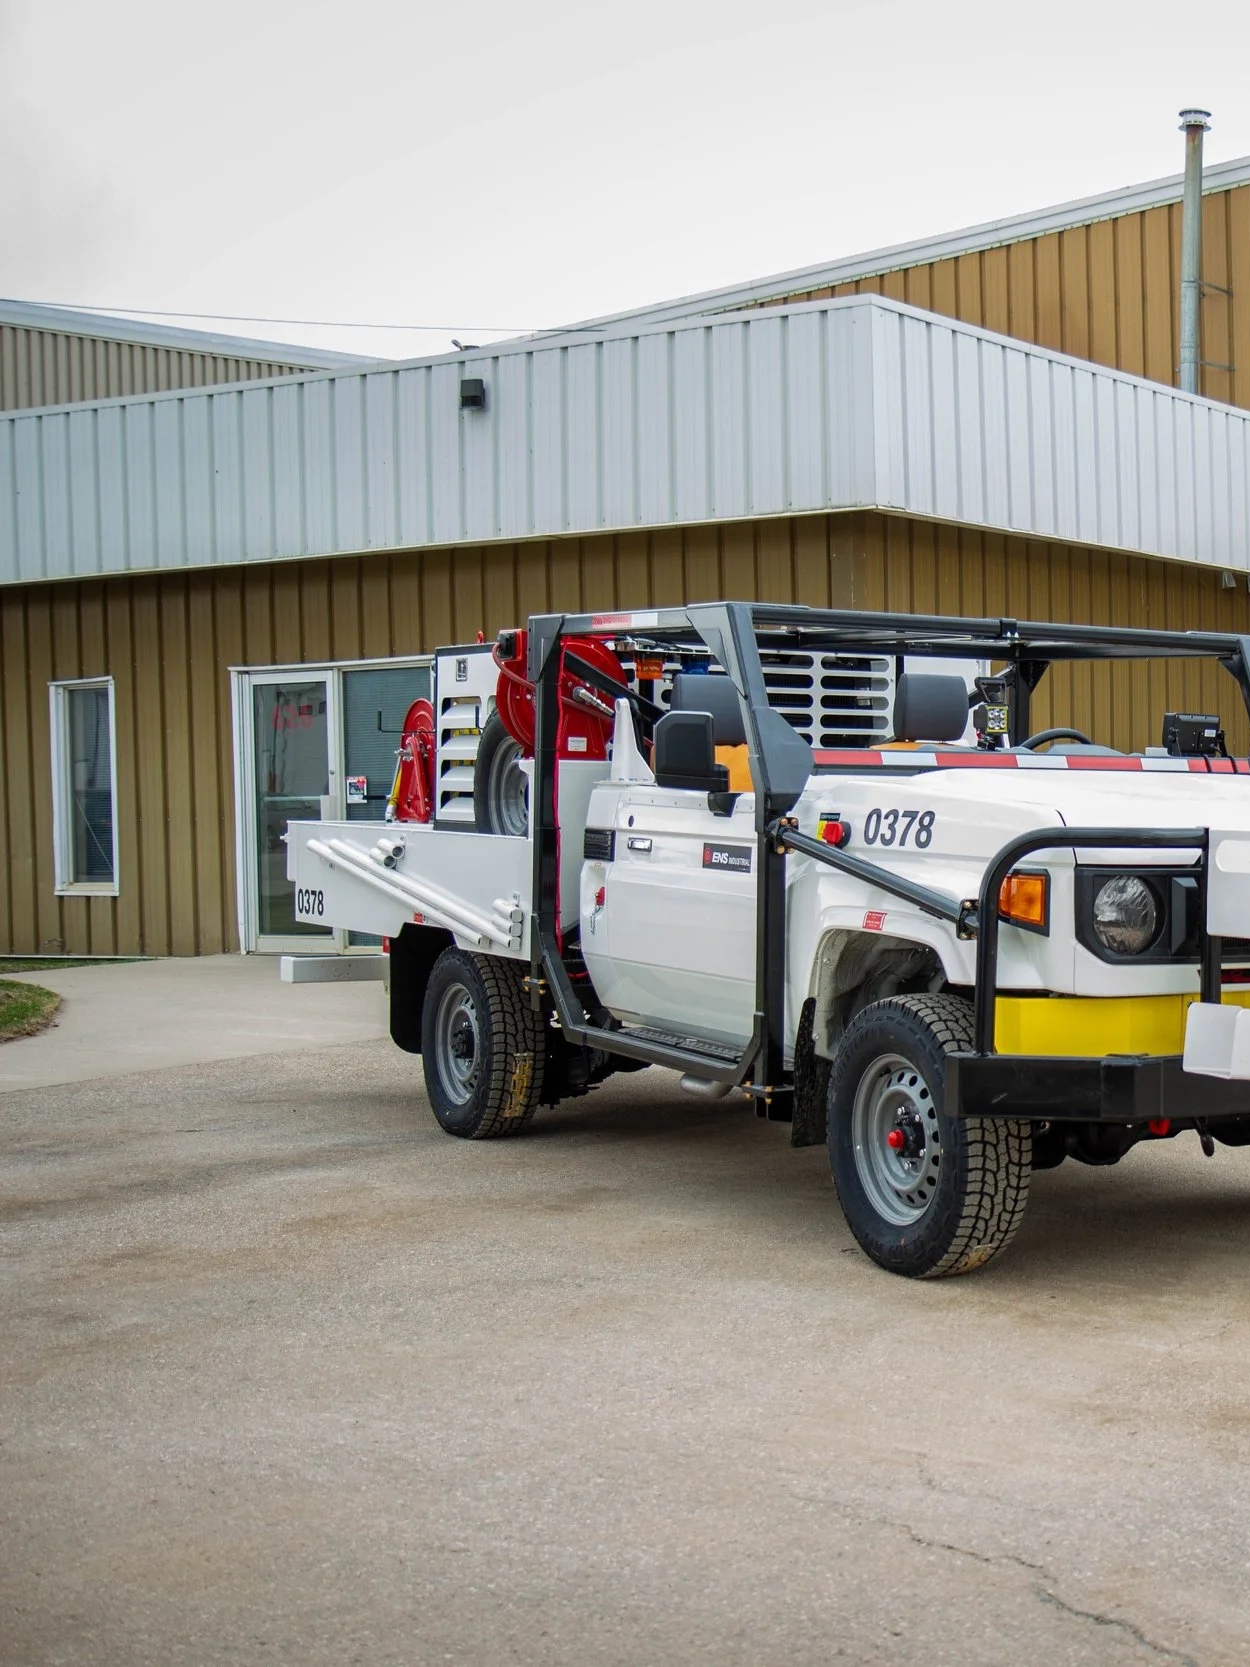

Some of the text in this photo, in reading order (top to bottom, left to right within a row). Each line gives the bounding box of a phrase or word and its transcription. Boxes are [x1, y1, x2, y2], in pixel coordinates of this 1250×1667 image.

[863, 808, 936, 849] 0378
[711, 851, 751, 867] ENS INDUSTRIAL
[297, 888, 325, 916] 0378
